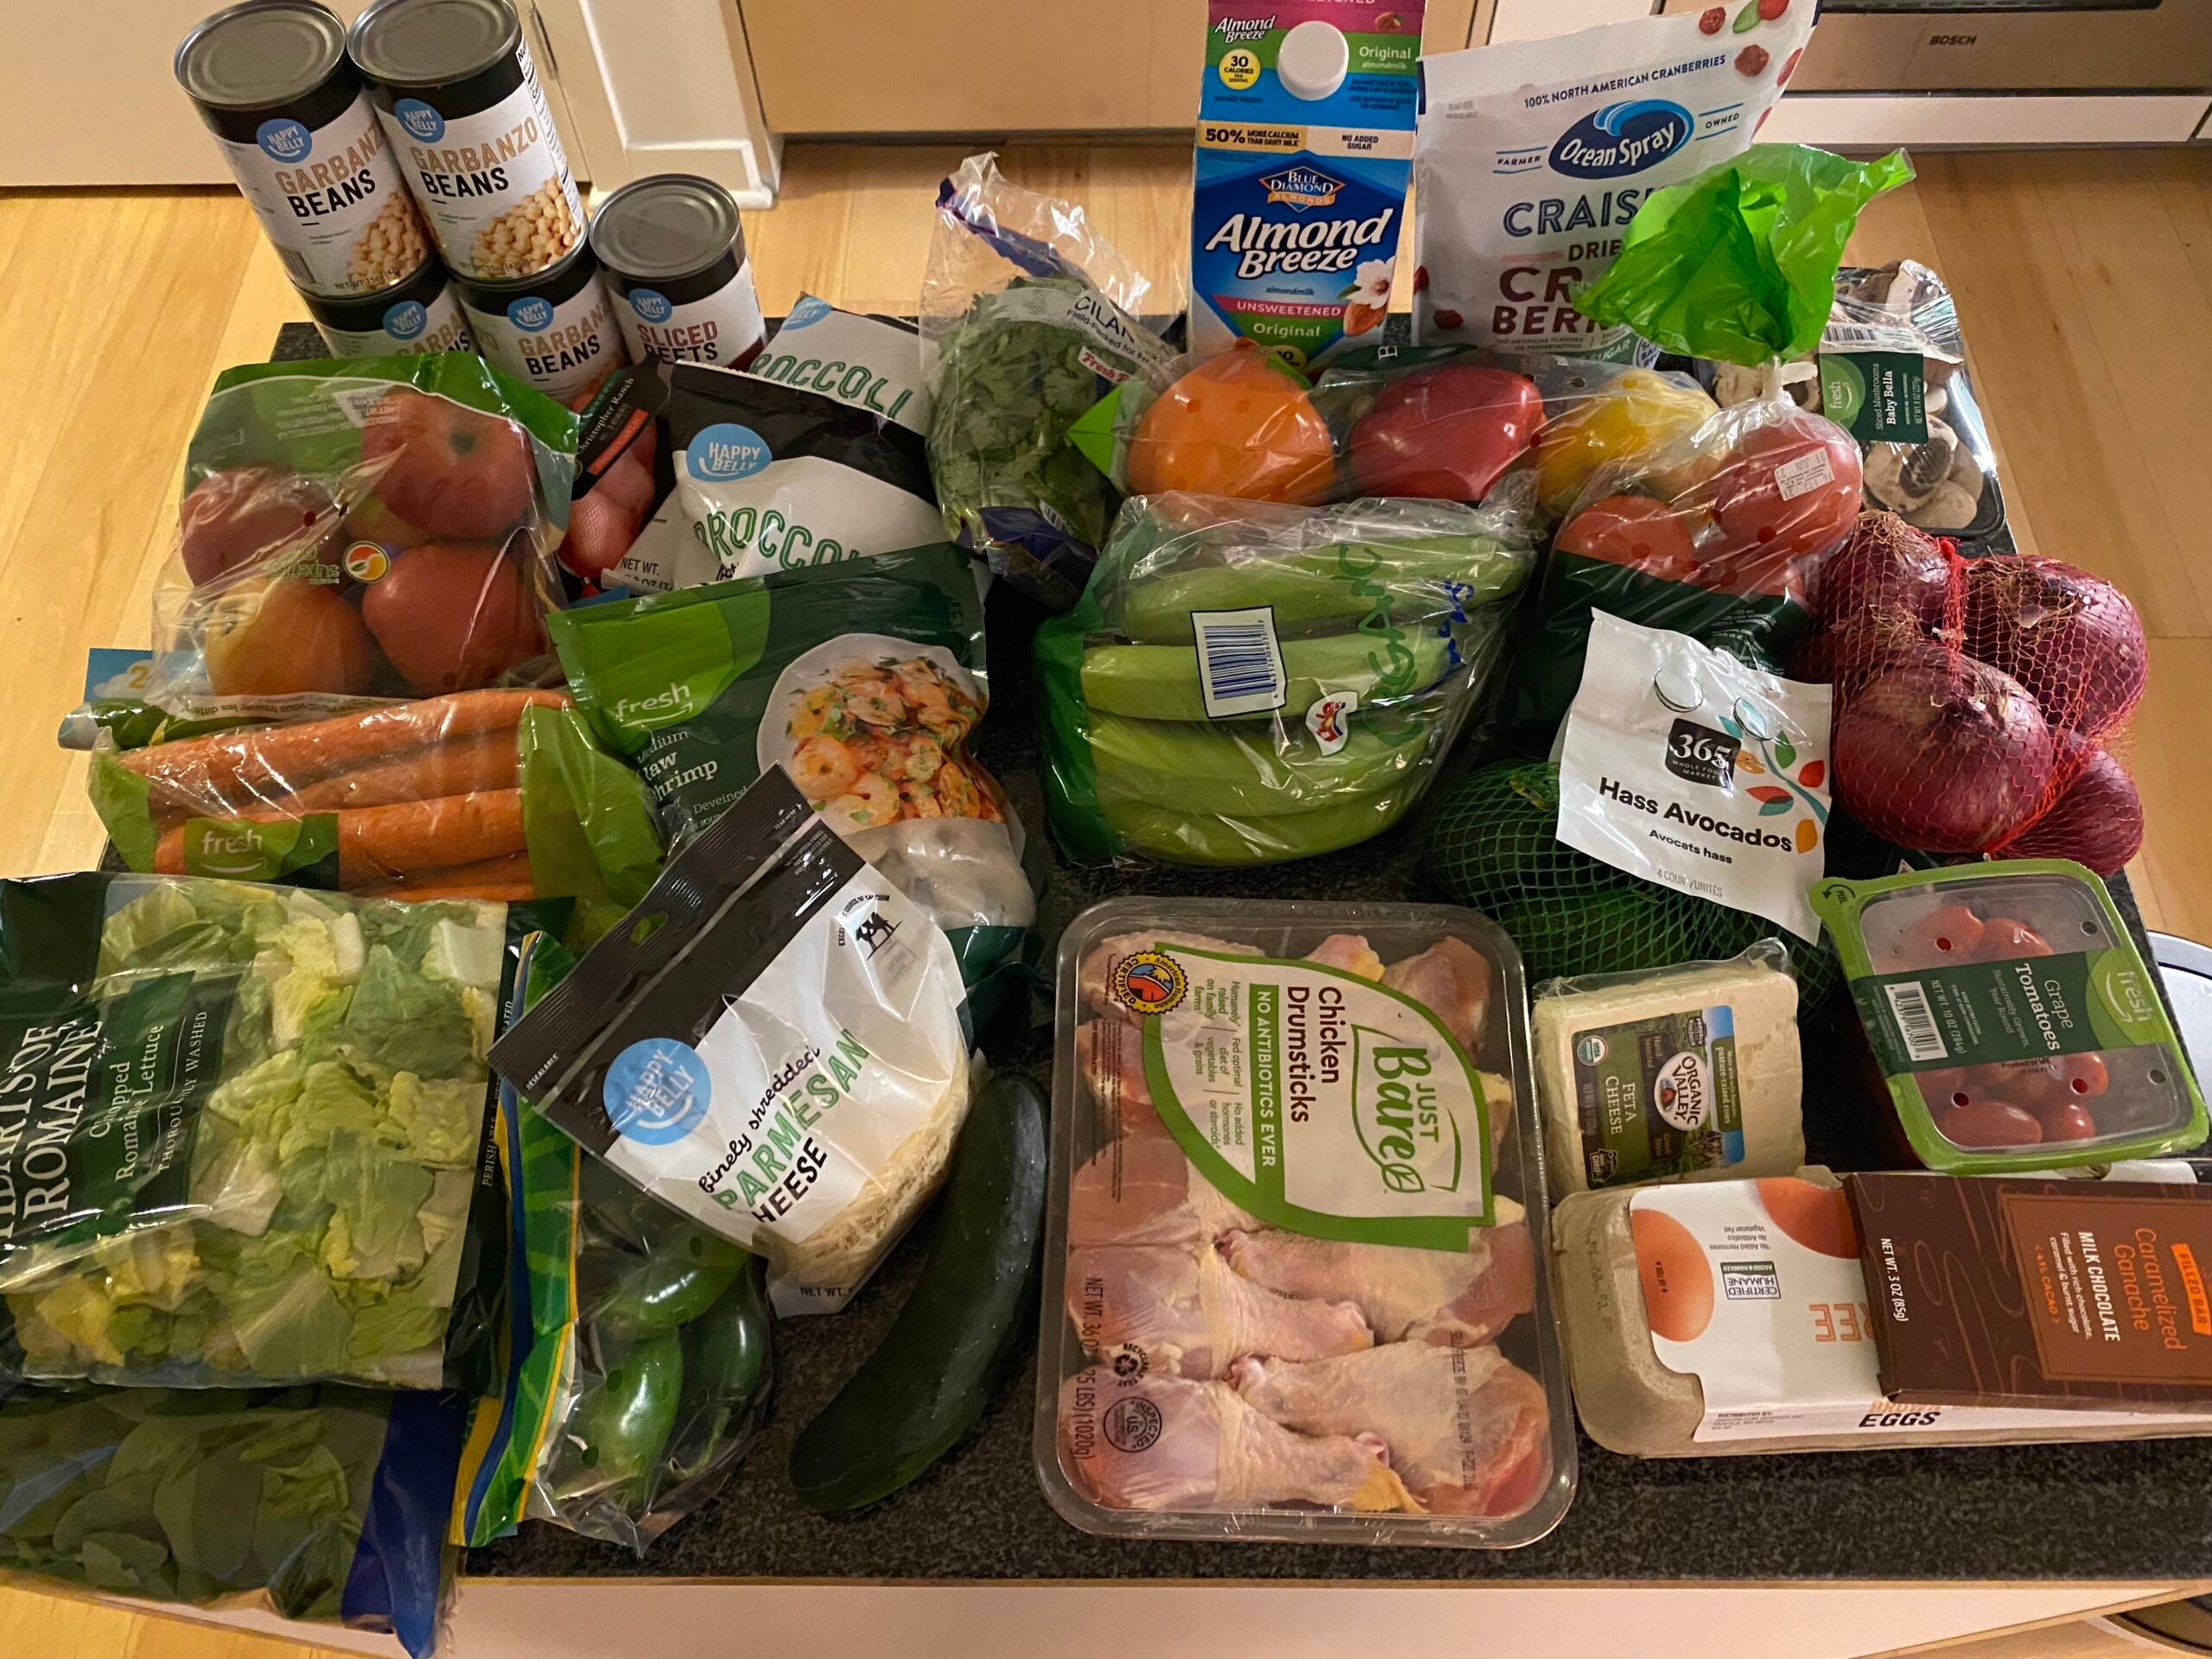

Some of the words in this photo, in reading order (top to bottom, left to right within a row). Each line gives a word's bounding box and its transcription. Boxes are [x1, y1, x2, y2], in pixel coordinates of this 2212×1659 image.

[1215, 16, 1275, 35] Almond
[1225, 29, 1265, 43] Breeze
[1359, 46, 1411, 60] Original
[1929, 35, 1977, 46] BOSCH
[1230, 55, 1249, 68] 30
[1362, 61, 1407, 70] almondmilk
[1524, 94, 1550, 109] 100%
[1551, 85, 1589, 103] NORTH
[1591, 73, 1649, 95] AMERICAN
[1651, 54, 1726, 81] CRANBERRIES
[404, 109, 432, 124] HAPPY
[1705, 112, 1740, 130] OWNED
[267, 125, 298, 145] HAPPY
[275, 136, 304, 153] BELLY
[410, 117, 538, 173] GARBANZO
[1205, 129, 1245, 144] 50%
[1342, 134, 1352, 143] NO
[1354, 135, 1378, 144] ADDED
[1346, 142, 1372, 150] SUGAR
[1560, 138, 1616, 168] Ocean
[1618, 121, 1676, 167] Spray
[1497, 156, 1541, 166] FARMER
[420, 167, 509, 198] BEANS
[1270, 179, 1333, 194] DIAMOND
[1288, 171, 1318, 184] BLUE
[287, 168, 376, 218] BEANS
[1274, 194, 1331, 205] ALMONDS
[1205, 207, 1394, 252] Almond
[1238, 247, 1357, 278] Breeze
[636, 296, 662, 308] HAPPY
[1266, 287, 1314, 296] almondmilk
[392, 304, 418, 326] HAPPY
[516, 302, 544, 319] HAPPY
[1236, 301, 1341, 317] UNSWEETENED
[637, 321, 718, 346] SLICED
[1066, 309, 1122, 349] Field-Packed
[1122, 344, 1136, 356] for
[1253, 323, 1320, 338] Original
[524, 334, 601, 375] BEANS
[1082, 352, 1116, 378] Fresh
[611, 377, 634, 406] Ranch
[1828, 381, 1843, 410] fresh
[1872, 363, 1882, 407] Mushrooms
[1883, 371, 1894, 397] Bella
[1875, 409, 1885, 430] Sliced
[1886, 397, 1898, 425] Baby
[709, 442, 760, 461] HAPPY
[712, 457, 758, 472] BELLY
[620, 557, 640, 569] NET
[642, 563, 660, 576] WT.
[616, 683, 690, 719] fresh
[1672, 760, 1700, 770] WHOLE
[1673, 734, 1732, 770] 365
[1682, 768, 1717, 780] MARKET
[693, 785, 748, 815] Deveined
[1599, 776, 1659, 816] Hass
[1663, 802, 1793, 853] Avocados
[201, 830, 263, 855] fresh
[1649, 829, 1700, 855] Avocats
[1702, 847, 1733, 865] hass
[1835, 889, 1847, 905] PEEL
[1116, 957, 1140, 1006] CERTIFIED
[1207, 978, 1214, 990] on
[1929, 979, 1939, 995] NET
[1204, 990, 1214, 1020] family
[1217, 987, 1227, 1014] raised
[1257, 991, 1271, 1014] NO
[1993, 969, 2017, 1017] Sustainably
[2014, 1013, 2029, 1048] Grown,
[2015, 963, 2060, 1052] Tomatoes
[2044, 979, 2074, 1030] Grape
[2117, 969, 2153, 1022] fresh
[1942, 1008, 1953, 1018] 10
[1946, 1018, 1958, 1030] OZ
[1990, 987, 2002, 1007] Year
[1997, 1005, 2016, 1034] Round
[1319, 986, 1342, 1085] Chicken
[1950, 1029, 1968, 1055] (284g)
[131, 1024, 164, 1097] Lettuce
[1192, 1049, 1202, 1075] grains
[1205, 1037, 1216, 1083] vegetables
[1287, 986, 1310, 1123] Drumsticks
[1645, 1038, 1655, 1069] Selected
[525, 1052, 560, 1091] RESEALABLE
[626, 1047, 674, 1113] HAPPY
[1222, 1065, 1230, 1076] of
[1231, 1053, 1243, 1087] optimal
[1257, 1017, 1274, 1119] ANTIBIOTICS
[1715, 1046, 1729, 1104] pasture-raised
[90, 1062, 130, 1139] Chopped
[157, 1077, 197, 1175] THOROUGHLY
[186, 1011, 207, 1074] WASHED
[648, 1063, 695, 1119] BELLY
[1373, 1046, 1432, 1160] Bare
[1622, 1083, 1636, 1122] FETA
[1671, 1064, 1688, 1121] VALLEY
[1681, 1055, 1702, 1126] ORGANIC
[1211, 1099, 1217, 1110] or
[1236, 1102, 1243, 1113] No
[1416, 1083, 1439, 1142] JUST
[1605, 1076, 1623, 1135] CHEESE
[22, 1020, 103, 1219] ROMAINE
[698, 1130, 753, 1194] finely
[748, 1045, 821, 1131] shredded
[712, 1027, 870, 1211] PARMESAN
[1222, 1103, 1230, 1147] hormones
[1234, 1114, 1244, 1146] added
[115, 1098, 149, 1184] Romaine
[1261, 1123, 1275, 1167] EVER
[1736, 1224, 1765, 1232] Vegetarian
[1879, 1238, 1893, 1256] NET
[2060, 1231, 2073, 1255] Filled
[2078, 1231, 2101, 1264] MILK
[1884, 1257, 1897, 1274] WT.
[2066, 1255, 2078, 1274] with
[800, 1287, 827, 1297] NET
[1085, 1277, 1103, 1298] NET
[1727, 1277, 1775, 1287] HUMANE
[1728, 1287, 1777, 1296] CERTIFIED
[1890, 1281, 1903, 1299] OZ
[2041, 1275, 2059, 1315] CACAO
[2049, 1236, 2066, 1273] caramel
[2061, 1281, 2073, 1307] burnt
[2067, 1307, 2080, 1334] sugar
[2072, 1274, 2083, 1294] rich
[2113, 1244, 2151, 1331] Ganache
[2135, 1228, 2188, 1350] Caramelized
[2179, 1254, 2202, 1295] FILLED
[2193, 1298, 2208, 1324] BAR
[1084, 1300, 1103, 1319] WT.
[1892, 1298, 1910, 1323] (85g)
[2075, 1294, 2093, 1339] chocolate,
[2087, 1266, 2120, 1342] CHOCOLATE
[1082, 1322, 1102, 1337] 36
[1072, 1387, 1095, 1413] LBS)
[1131, 1401, 1159, 1449] INSPECTED
[1859, 1411, 1942, 1427] EGGS
[1070, 1412, 1096, 1459] (1020g)
